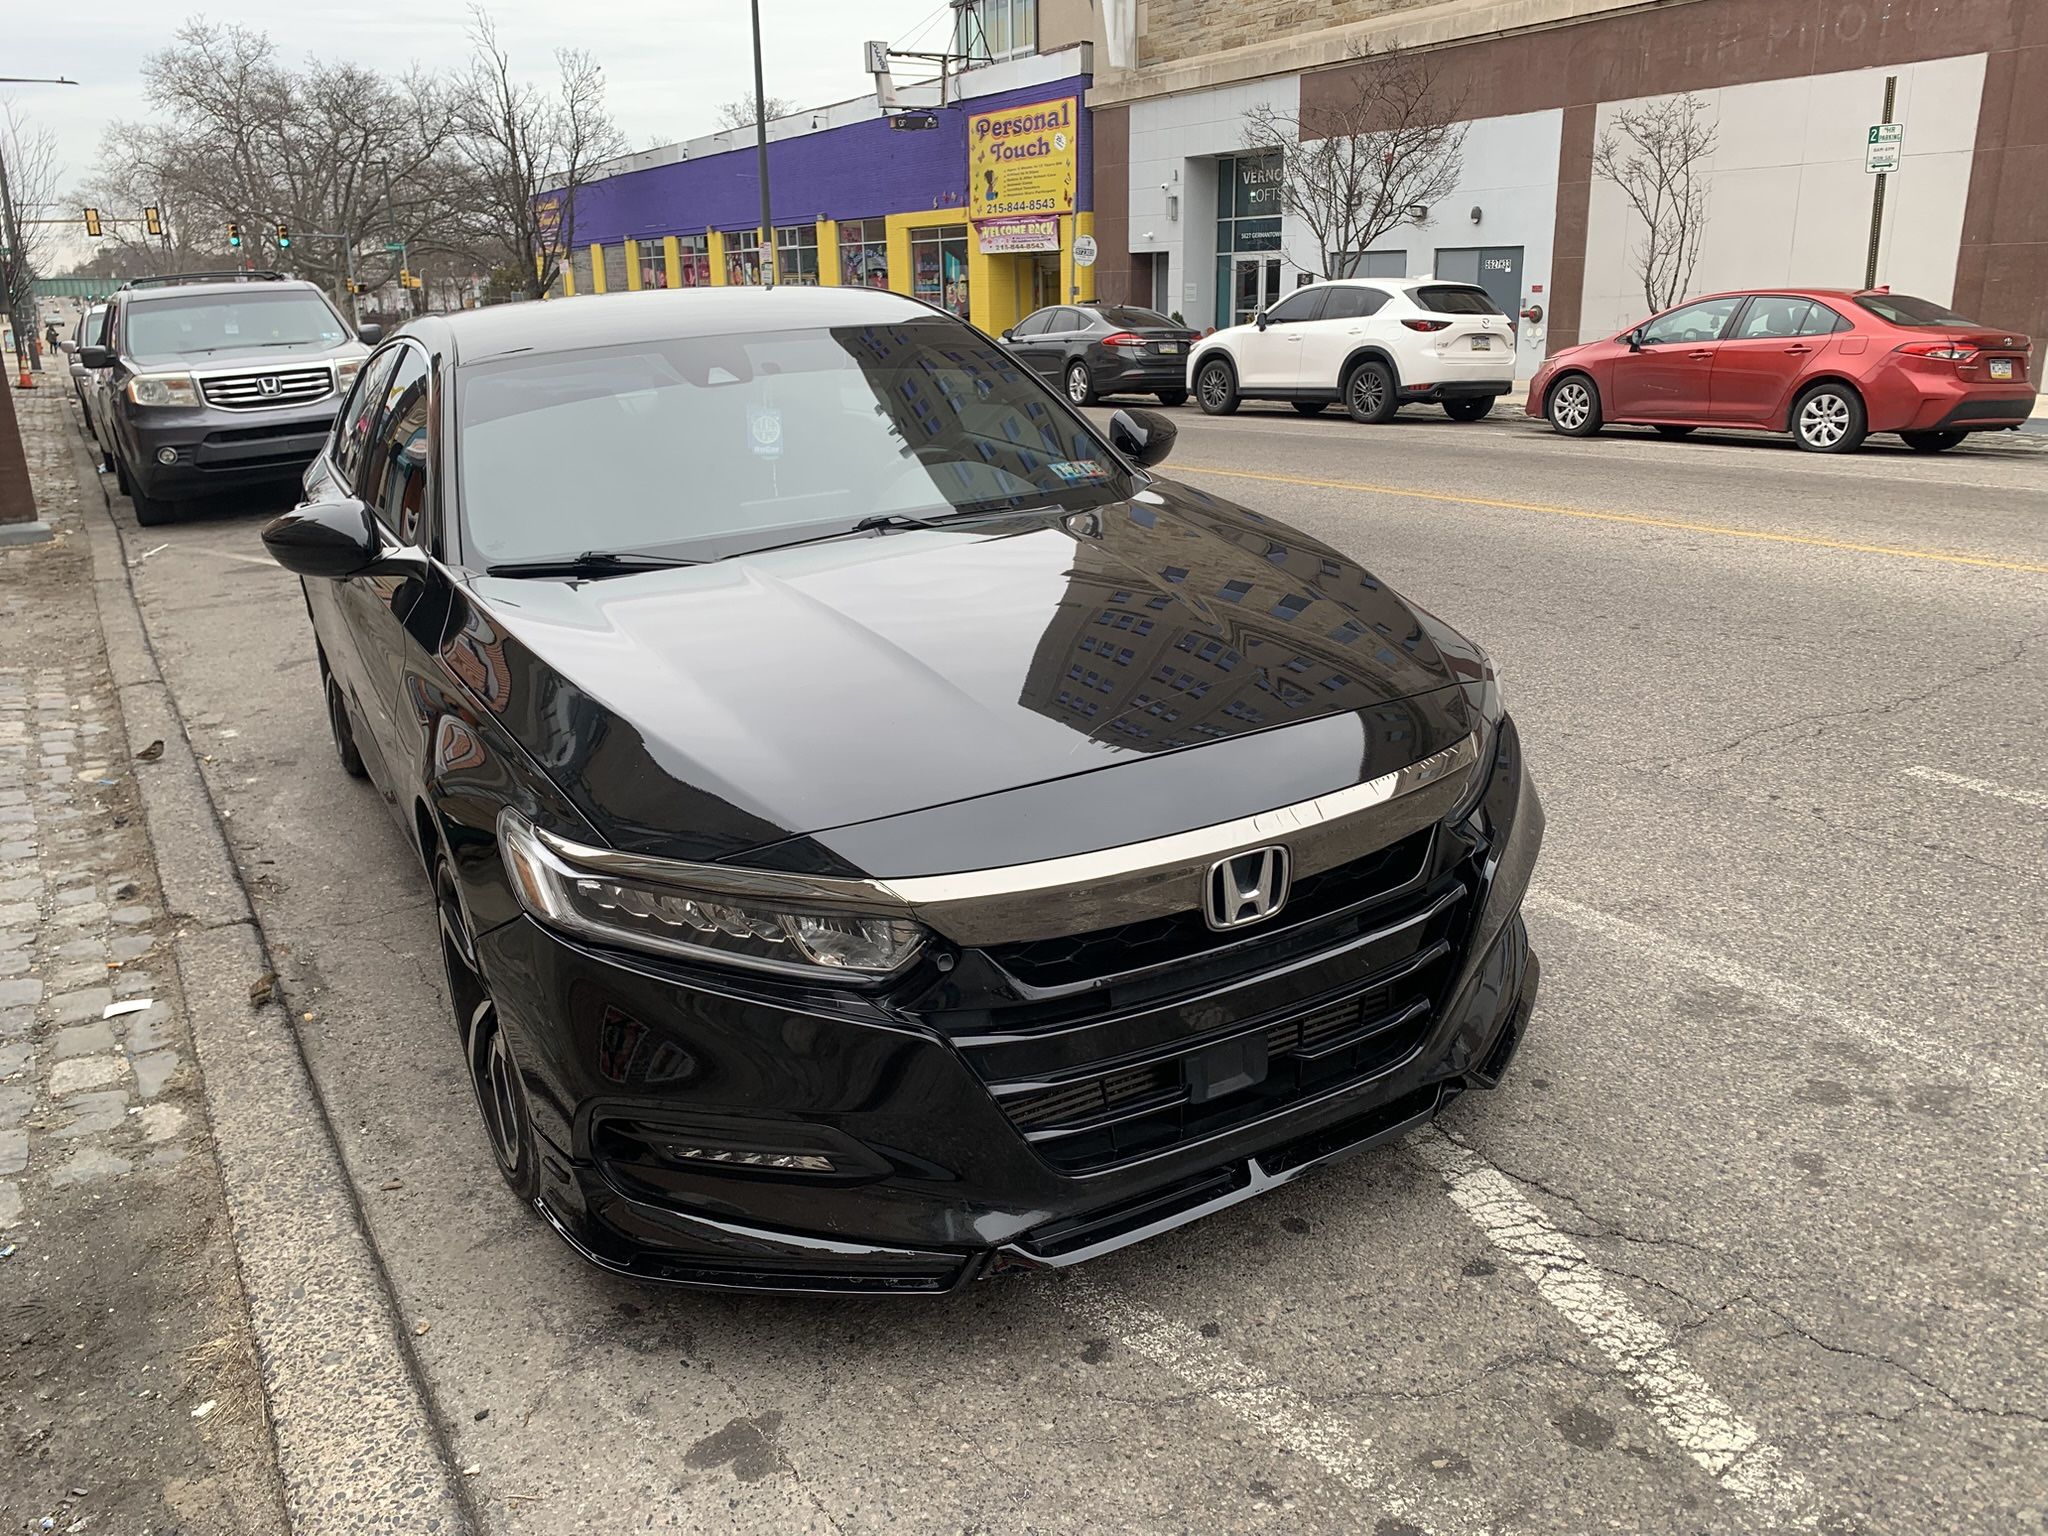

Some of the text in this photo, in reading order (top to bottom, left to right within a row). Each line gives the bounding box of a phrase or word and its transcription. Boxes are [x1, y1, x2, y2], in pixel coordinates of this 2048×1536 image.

[976, 102, 1070, 141] Personal
[1871, 129, 1877, 141] 2
[990, 136, 1051, 162] Touch
[1250, 188, 1282, 203] LOFTS
[986, 198, 1056, 214] 215-844-8543
[980, 221, 1055, 238] WELCOME BACK
